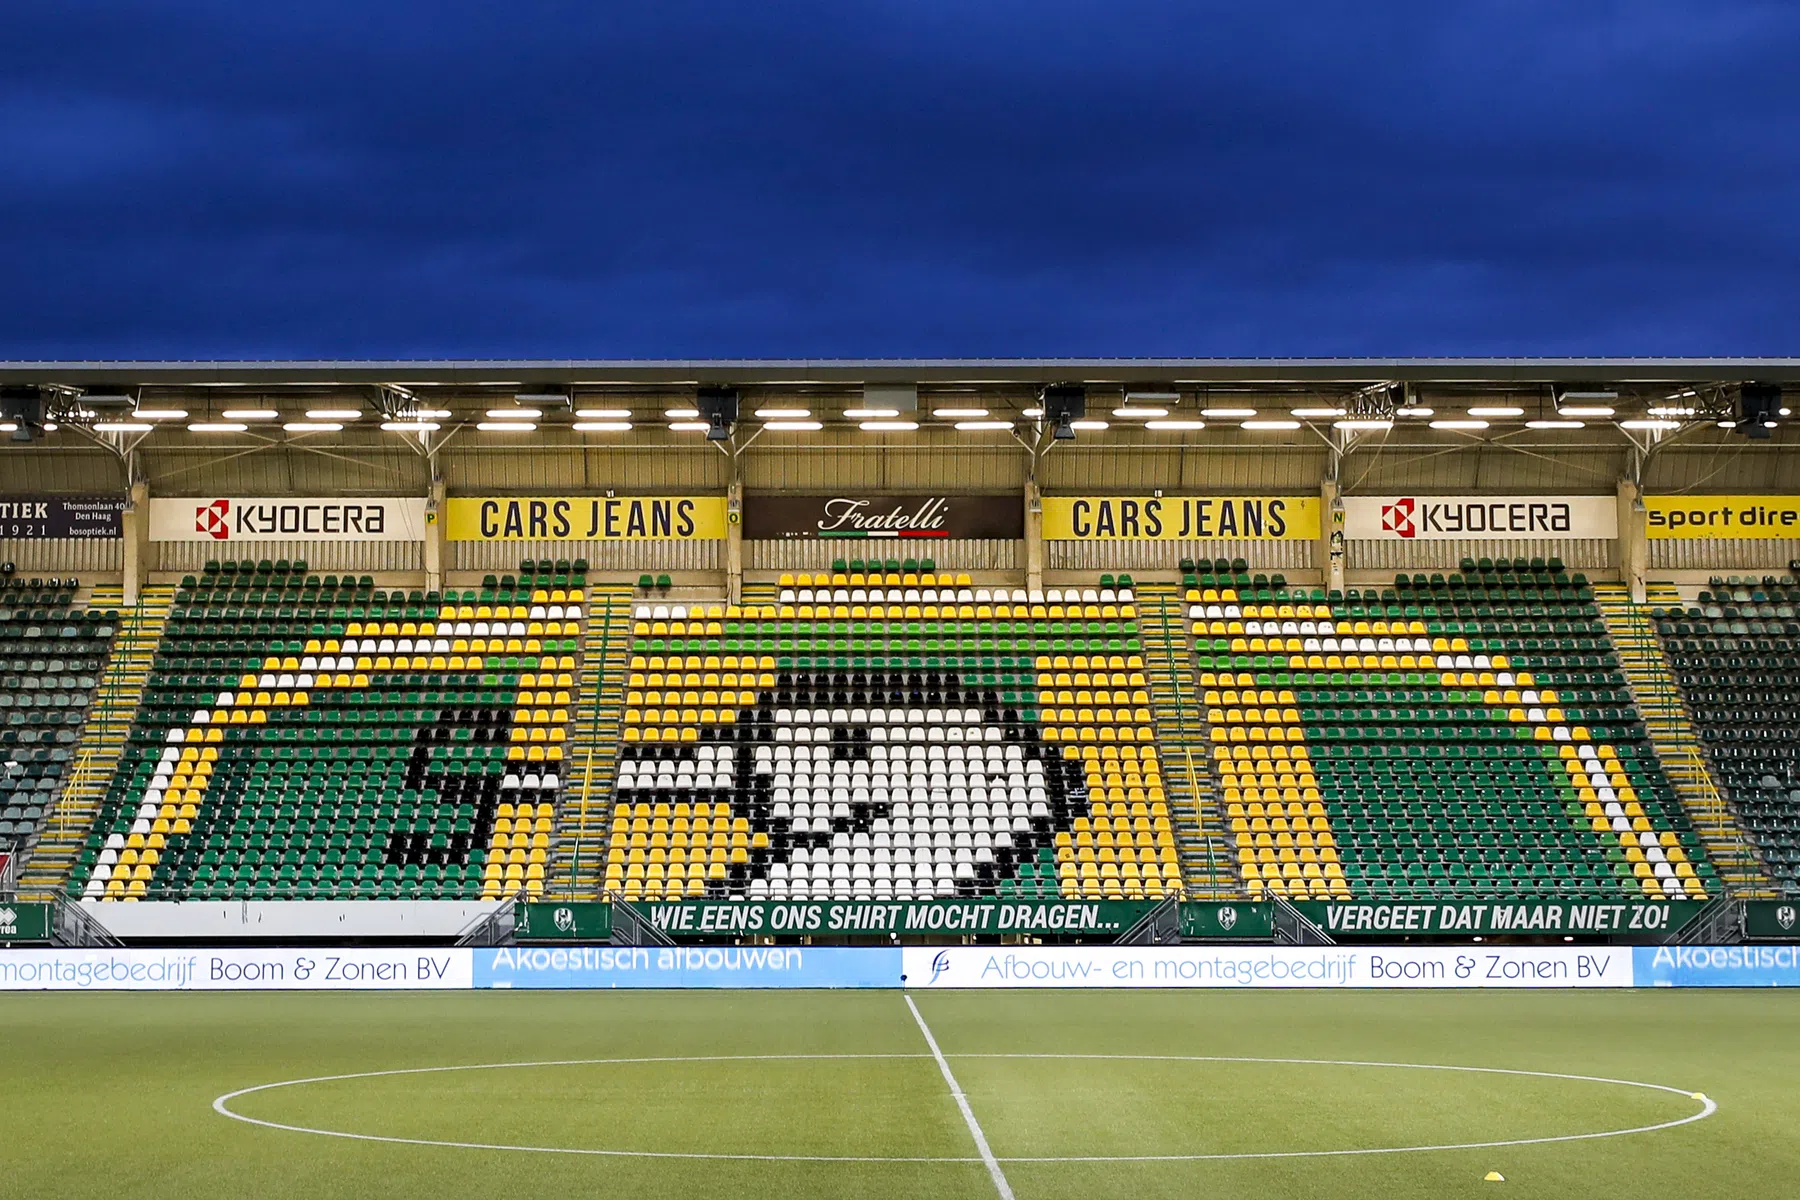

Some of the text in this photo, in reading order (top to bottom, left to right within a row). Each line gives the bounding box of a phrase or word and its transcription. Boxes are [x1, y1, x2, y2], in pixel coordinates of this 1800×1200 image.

[62, 502, 126, 511] Thomsonlaan 40
[75, 512, 112, 522] Den Haag
[427, 513, 436, 524] P
[480, 500, 695, 537] CARS JEANS
[817, 497, 949, 531] Fratelli
[1072, 499, 1287, 537] CARS JEANS
[1333, 512, 1343, 523] N
[1648, 507, 1734, 530] sport
[69, 526, 117, 538] bosoptiek.nl
[650, 904, 1120, 930] WIE EENS ONS SHIRT MOCHT DRAGEN...
[1439, 905, 1488, 930] DAT
[1490, 905, 1562, 930] MAAR
[1568, 905, 1626, 930] NIET
[1628, 905, 1670, 930] ZO!
[492, 946, 803, 971] Akoestisch afbouwen
[981, 954, 1611, 985] Afbouw- en montagebedrijf Boom & Zonen BV
[0, 956, 451, 987] montagebedrijf Boom & Zonen BV
